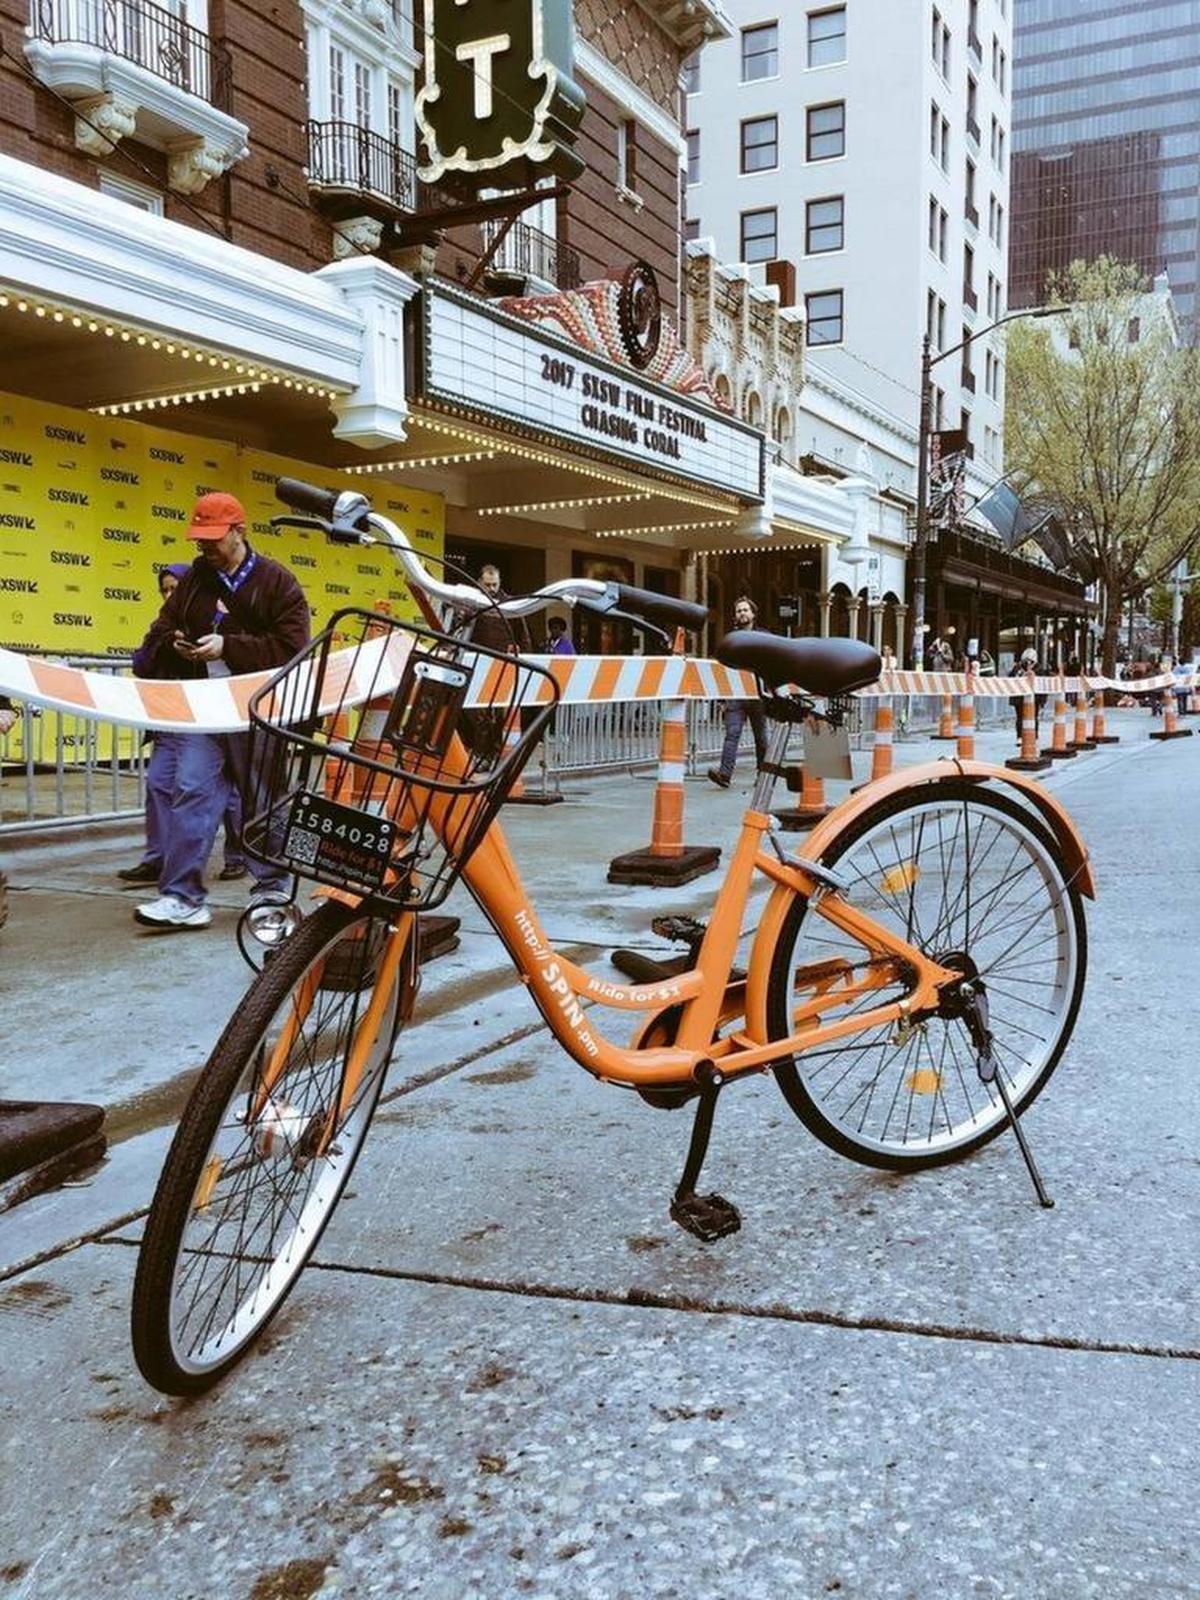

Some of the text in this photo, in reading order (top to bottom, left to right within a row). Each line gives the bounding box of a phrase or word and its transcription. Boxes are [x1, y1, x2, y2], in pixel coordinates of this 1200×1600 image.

[541, 354, 708, 443] 2017 SXSW FILM FESTIVAL
[45, 424, 80, 444] SXSW
[581, 404, 681, 460] CHASING CORAL
[149, 447, 178, 463] SXSW
[100, 467, 132, 484] SXSW
[48, 488, 82, 505] SXSW
[152, 504, 179, 519] SXSW
[102, 527, 133, 543] SXSW
[50, 550, 81, 566] SXSW
[103, 587, 133, 600] SXSW
[53, 612, 83, 627] SXSW
[294, 809, 390, 853] 1584028
[541, 962, 585, 1029] SPIN
